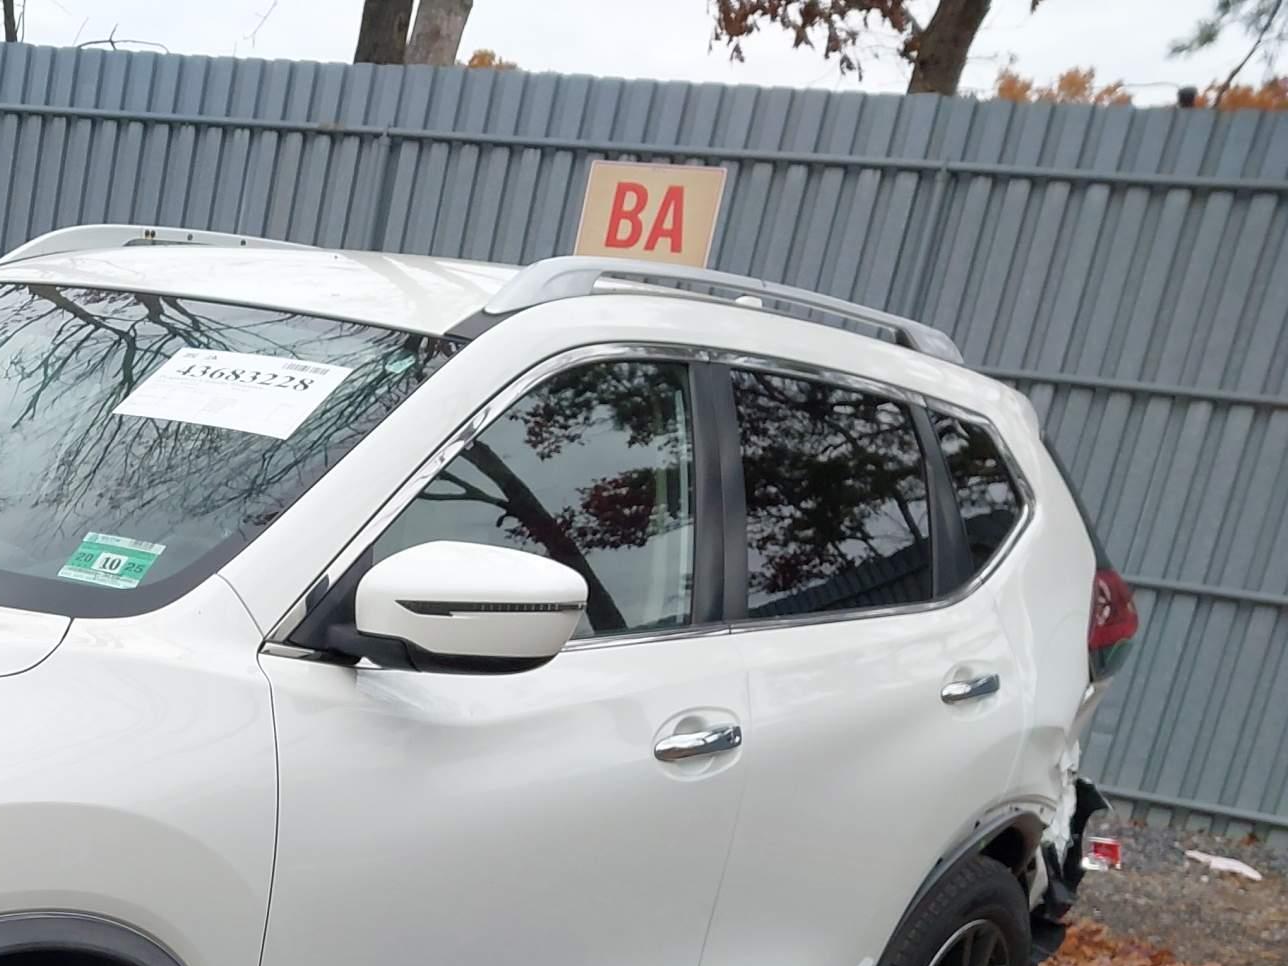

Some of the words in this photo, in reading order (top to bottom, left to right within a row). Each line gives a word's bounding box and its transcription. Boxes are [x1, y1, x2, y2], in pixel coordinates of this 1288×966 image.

[604, 181, 685, 253] BA
[177, 363, 314, 392] 43683228
[74, 552, 95, 563] 20
[101, 556, 122, 571] 10
[124, 561, 145, 574] 25
